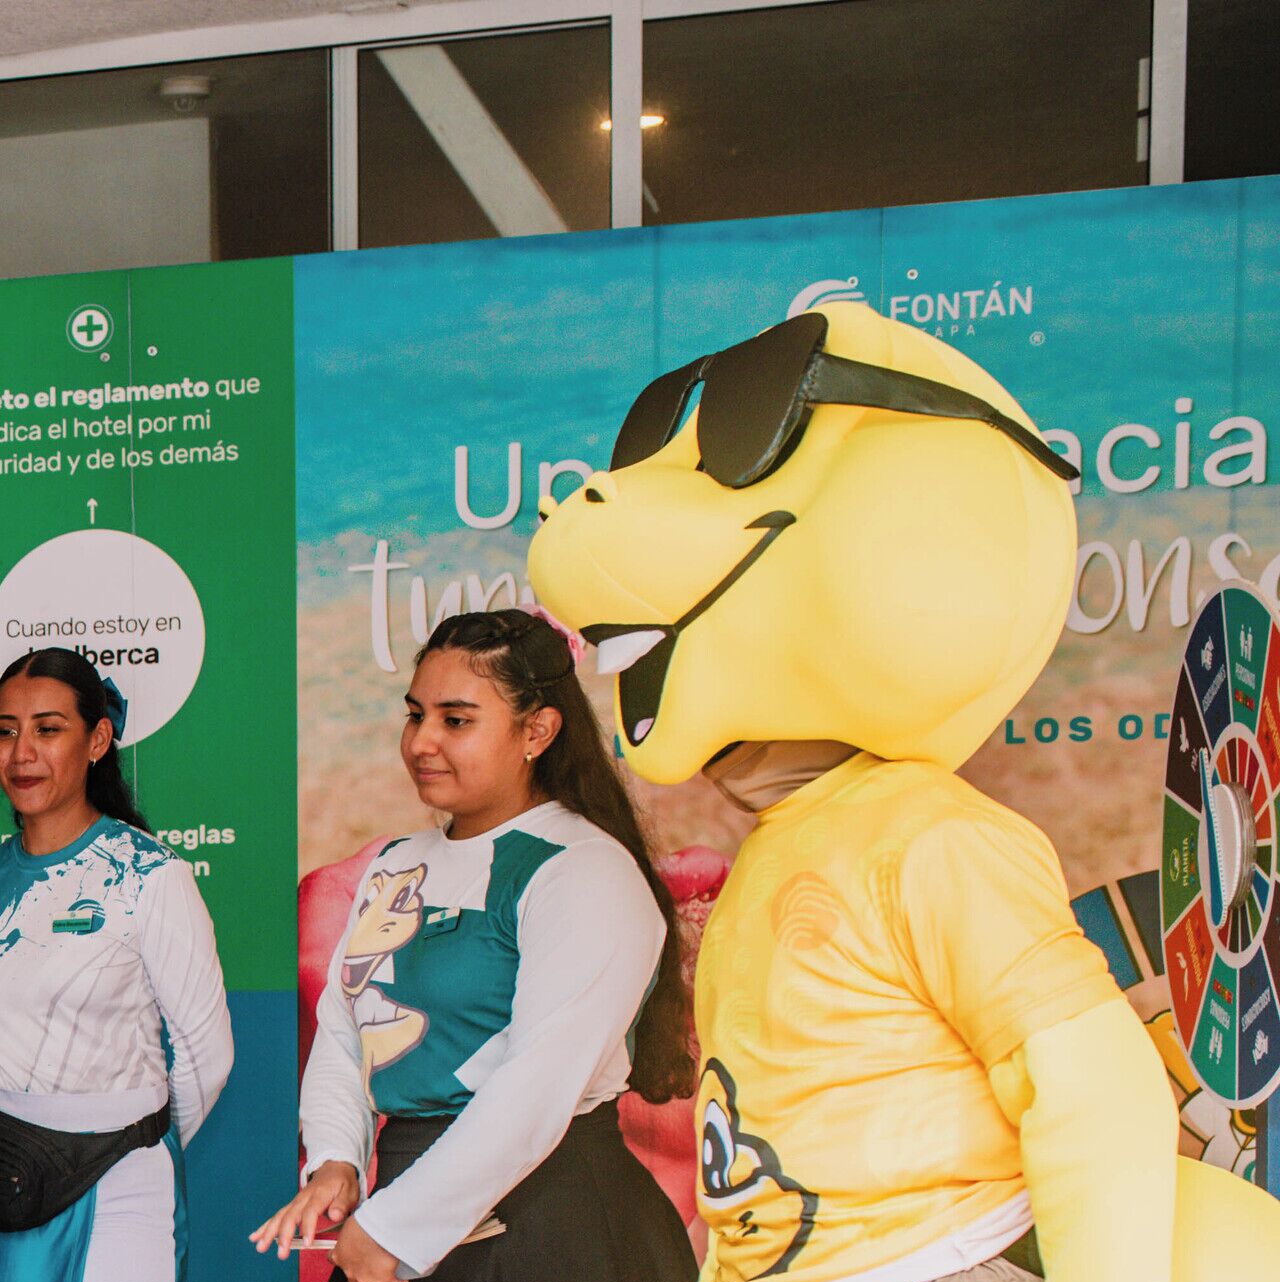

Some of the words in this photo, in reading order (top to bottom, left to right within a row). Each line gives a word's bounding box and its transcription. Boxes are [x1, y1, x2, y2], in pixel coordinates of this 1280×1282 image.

[890, 280, 1033, 323] FONTÁN
[34, 386, 57, 407] el
[62, 377, 209, 409] reglamento
[215, 374, 260, 400] que
[48, 418, 67, 438] el
[73, 414, 132, 437] hotel
[139, 413, 177, 438] por
[182, 409, 211, 430] mi
[67, 453, 81, 475] y
[86, 448, 115, 469] de
[122, 446, 153, 467] los
[159, 439, 239, 465] demás
[6, 615, 87, 639] Cuando
[93, 614, 149, 637] estoy
[155, 614, 182, 632] en
[1005, 715, 1093, 744] LOS
[157, 824, 236, 850] reglas
